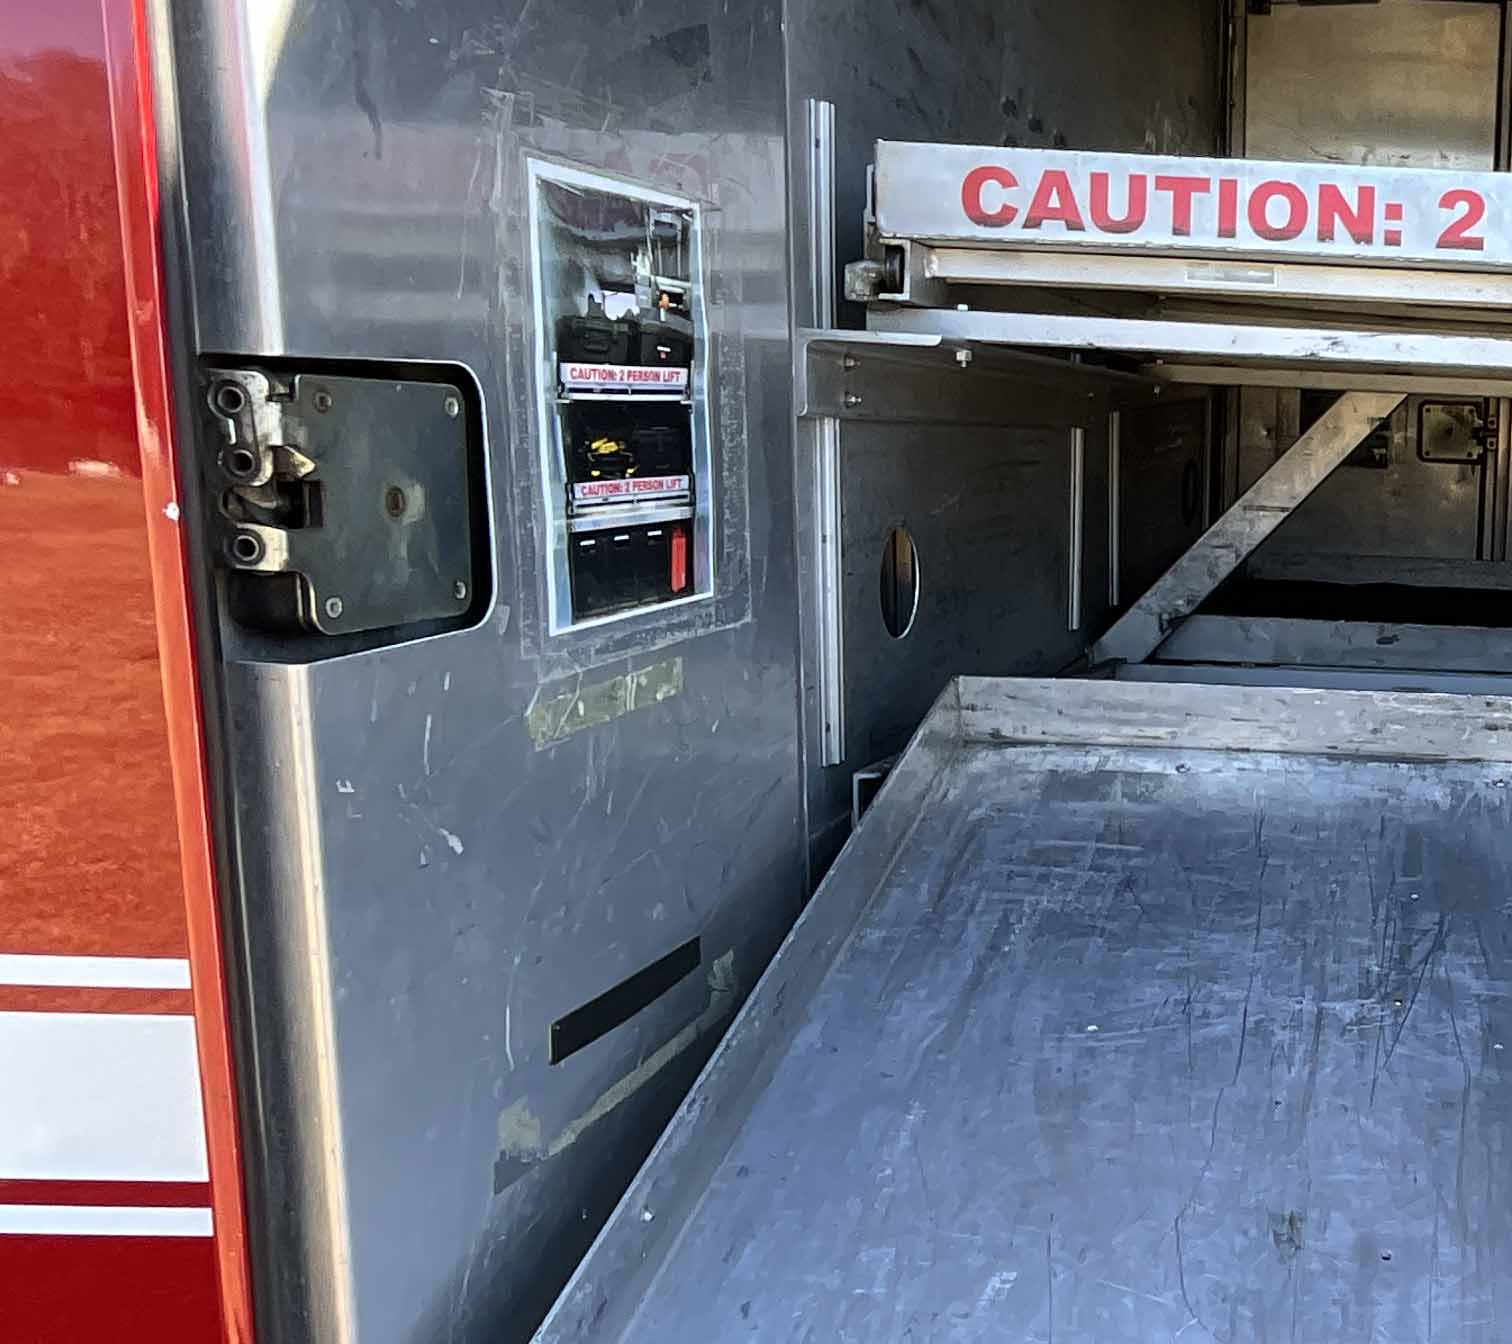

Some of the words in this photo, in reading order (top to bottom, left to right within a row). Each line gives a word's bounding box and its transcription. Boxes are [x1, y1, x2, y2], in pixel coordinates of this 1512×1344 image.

[961, 164, 1404, 246] CAUTION:
[1436, 189, 1485, 251] 2
[619, 370, 625, 382] 2
[627, 370, 661, 382] PERSON
[662, 371, 681, 382] LIFT
